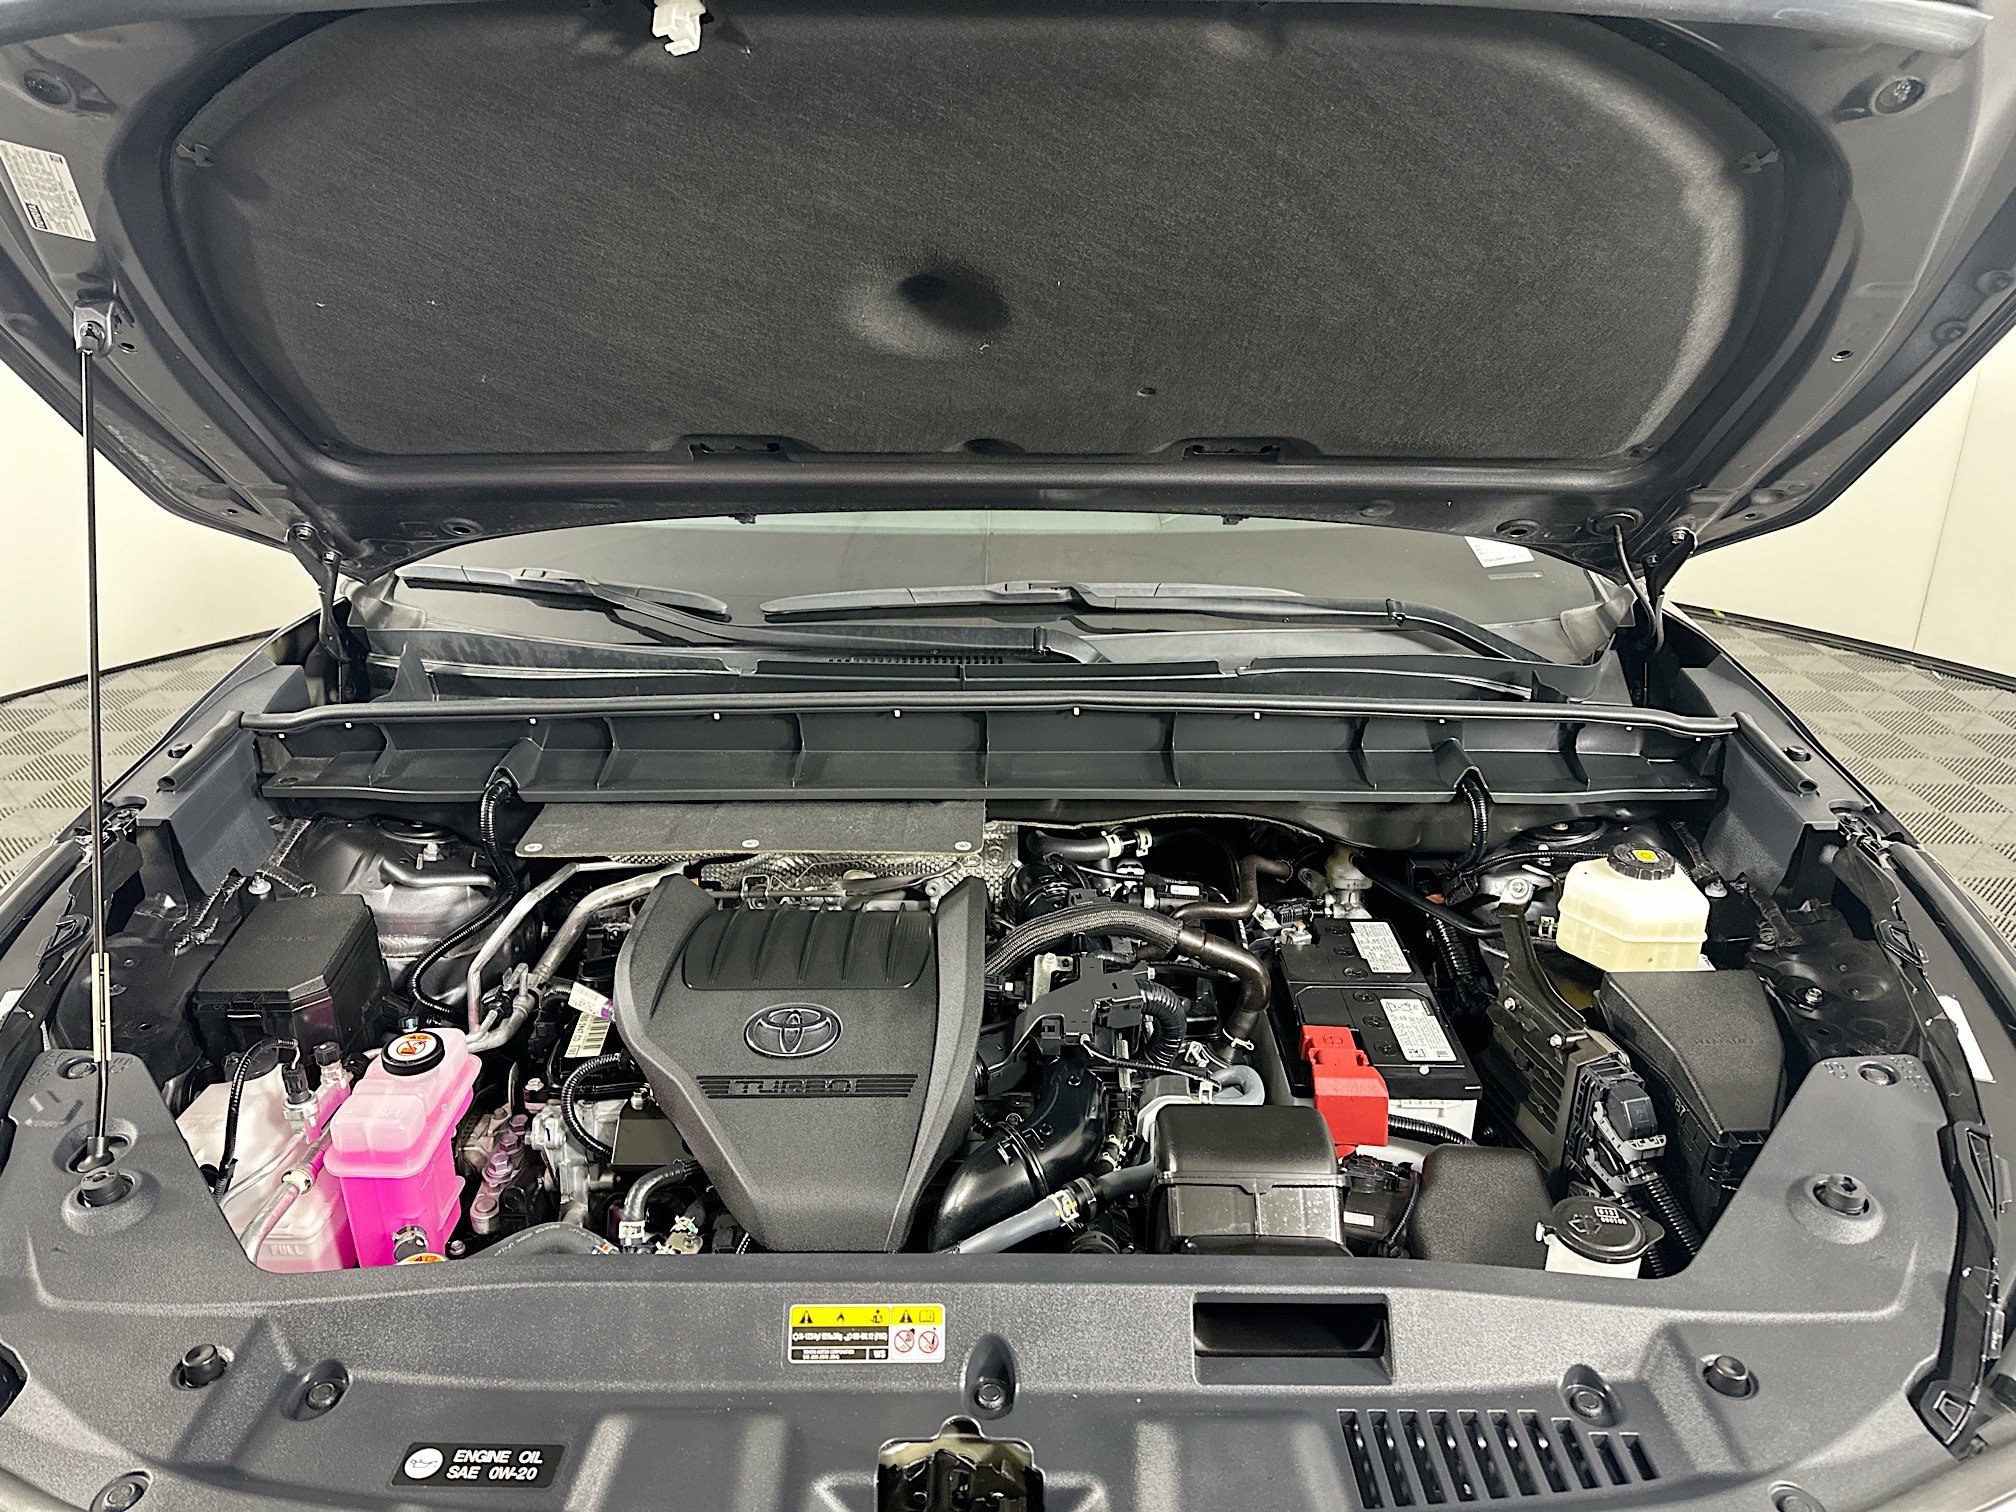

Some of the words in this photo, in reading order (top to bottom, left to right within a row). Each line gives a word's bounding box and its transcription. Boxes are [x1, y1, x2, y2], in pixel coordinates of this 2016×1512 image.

[735, 1079, 852, 1094] TURBO
[270, 1245, 304, 1256] FULL
[453, 1450, 512, 1464] ENGINE
[518, 1450, 544, 1465] OIL
[446, 1465, 481, 1480] SAE
[488, 1466, 538, 1481] 0W-20
